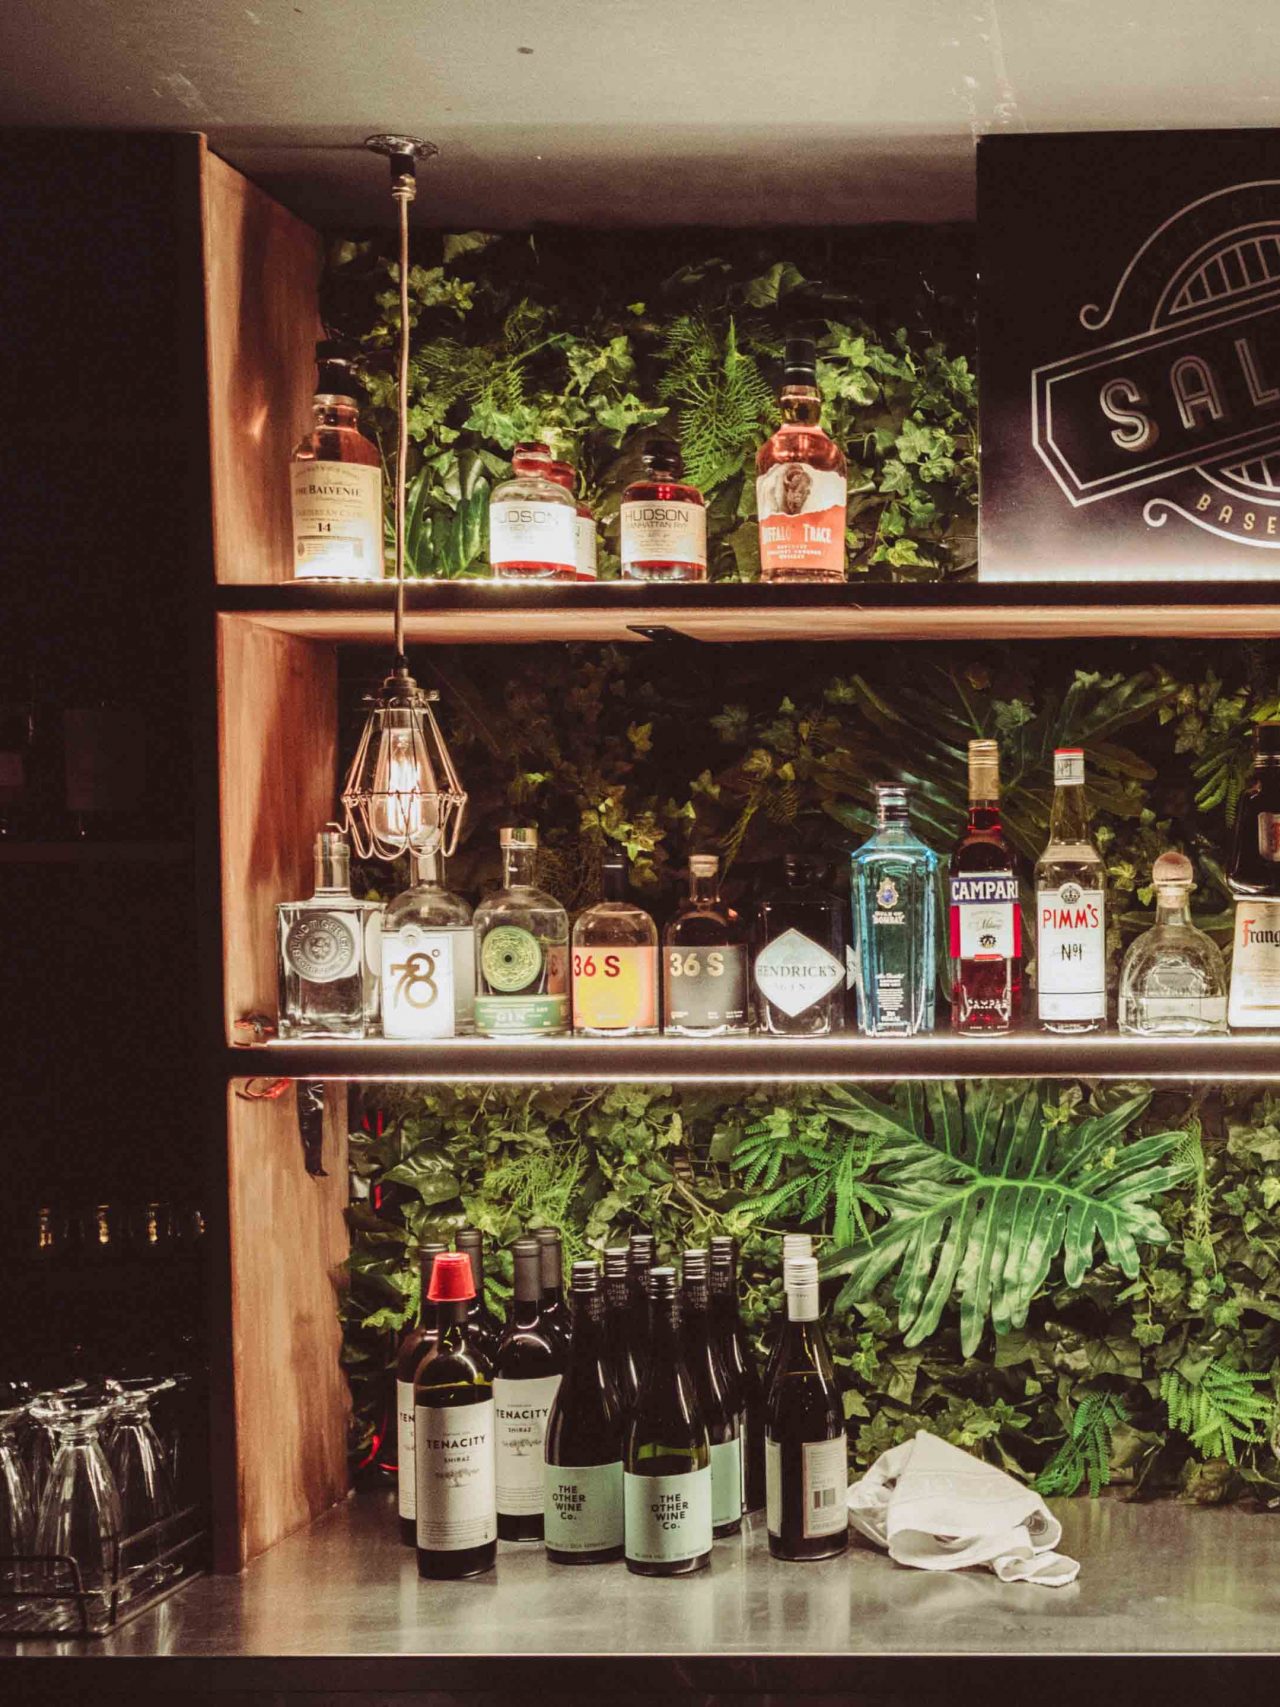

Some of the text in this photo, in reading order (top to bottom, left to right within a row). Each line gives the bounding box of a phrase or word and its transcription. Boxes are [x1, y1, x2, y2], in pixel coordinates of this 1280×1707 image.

[625, 507, 689, 522] HUDSON
[951, 880, 1019, 900] CAMPARI
[1042, 904, 1099, 929] PIMM'S
[574, 954, 621, 977] 36 S
[669, 952, 725, 977] 36 S
[757, 964, 837, 977] HENDRICK'S
[496, 1408, 549, 1420] TENACITY
[426, 1435, 487, 1450] TENACITY
[444, 1456, 471, 1464] SHIRAZ
[558, 1485, 578, 1493] THE
[552, 1493, 586, 1502] OTHER
[660, 1493, 681, 1502] THE
[556, 1502, 583, 1511] WINE
[652, 1501, 689, 1512] OTHER
[560, 1512, 577, 1520] Co.
[656, 1512, 686, 1521] WINE
[662, 1521, 681, 1530] Co.
